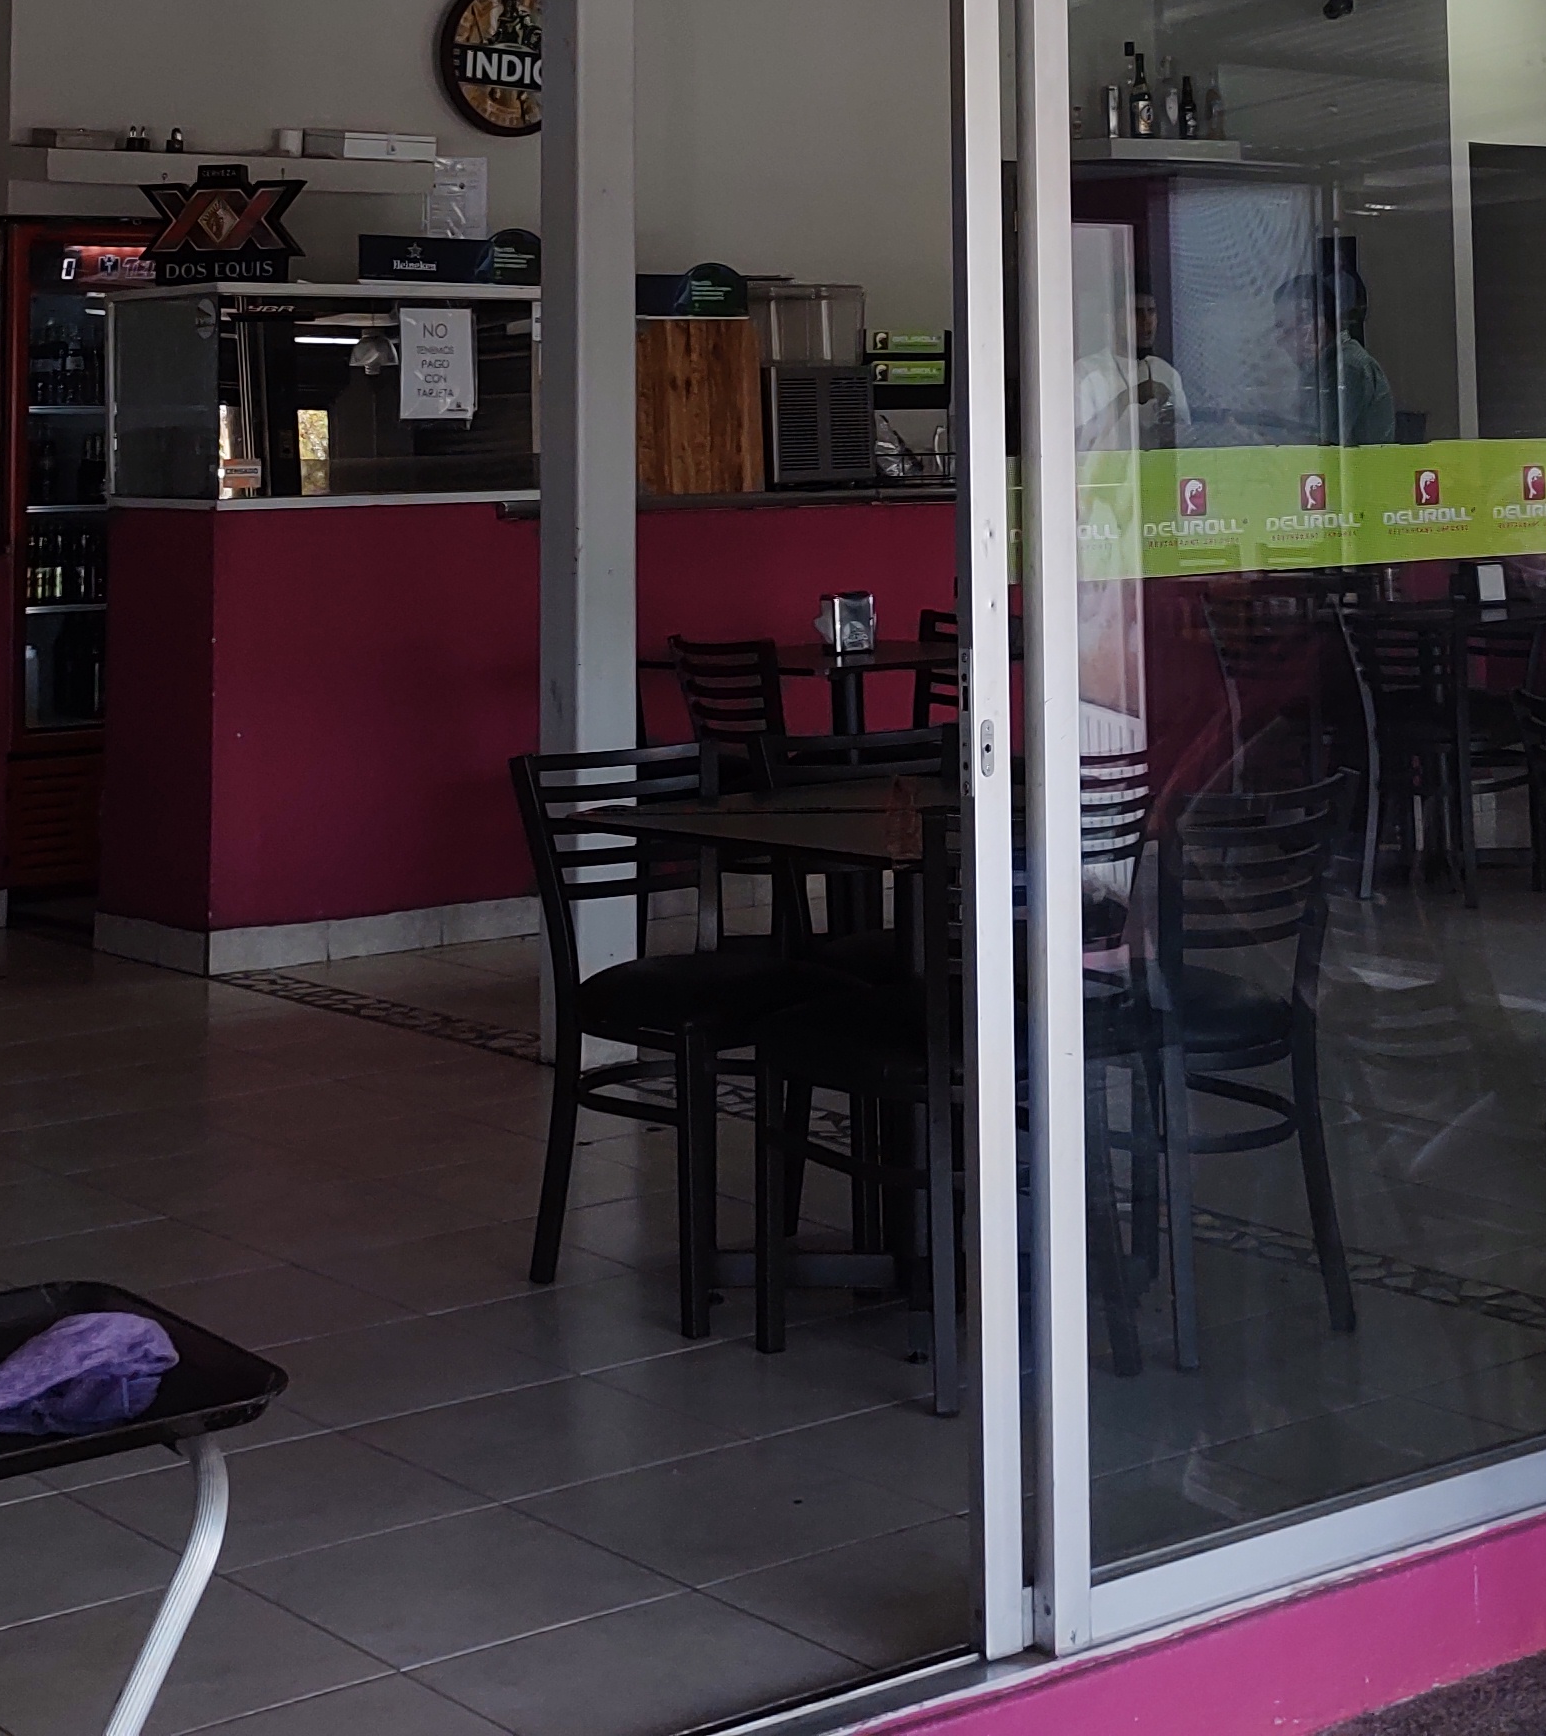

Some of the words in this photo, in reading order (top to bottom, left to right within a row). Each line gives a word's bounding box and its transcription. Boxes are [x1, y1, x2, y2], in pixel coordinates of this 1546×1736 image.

[165, 263, 207, 279] DOS
[213, 260, 274, 278] EQUIS
[392, 259, 438, 272] Heineken
[422, 323, 448, 339] NO
[421, 359, 450, 369] PAGO
[424, 374, 447, 383] CON
[417, 388, 455, 398] TARJETA
[1265, 512, 1362, 531] DELIROLL
[1383, 507, 1473, 525] DELIROLL
[1143, 519, 1245, 537] DELIROLL
